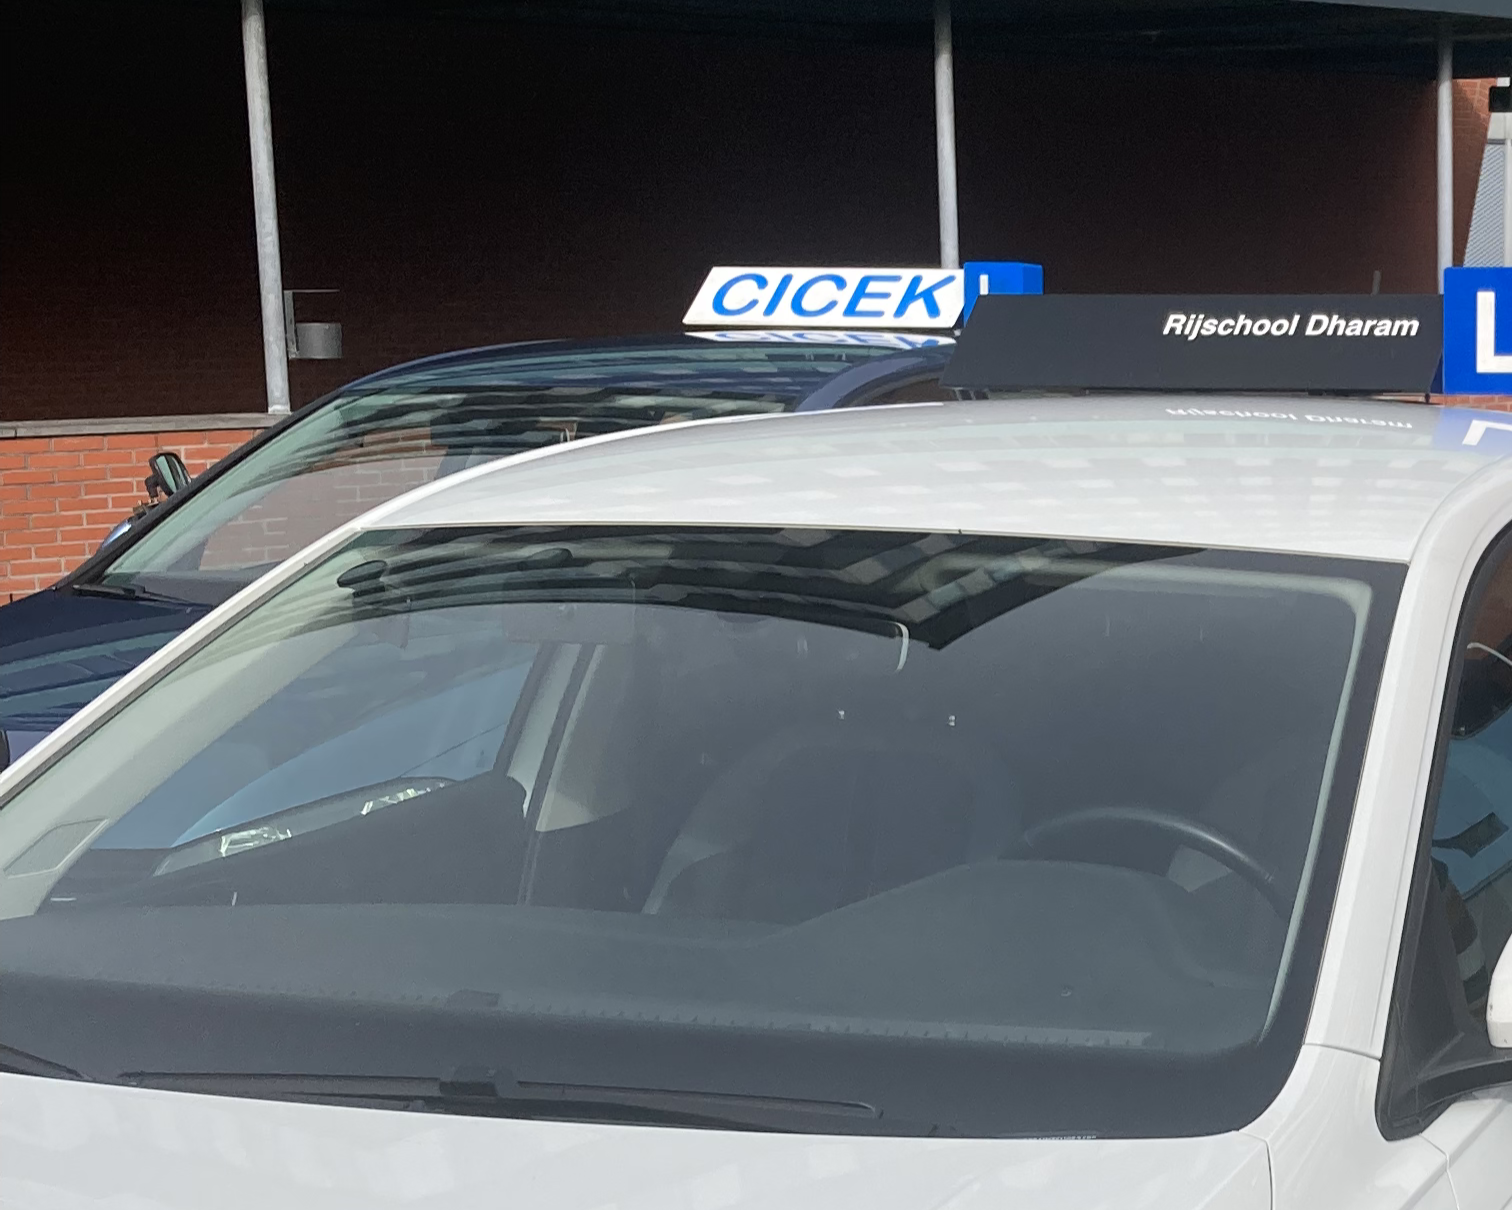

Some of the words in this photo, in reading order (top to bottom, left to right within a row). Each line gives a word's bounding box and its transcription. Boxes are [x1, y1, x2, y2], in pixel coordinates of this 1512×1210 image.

[712, 273, 956, 319] CICEK
[1162, 313, 1300, 341] Rijschool
[1305, 313, 1420, 337] Dharam
